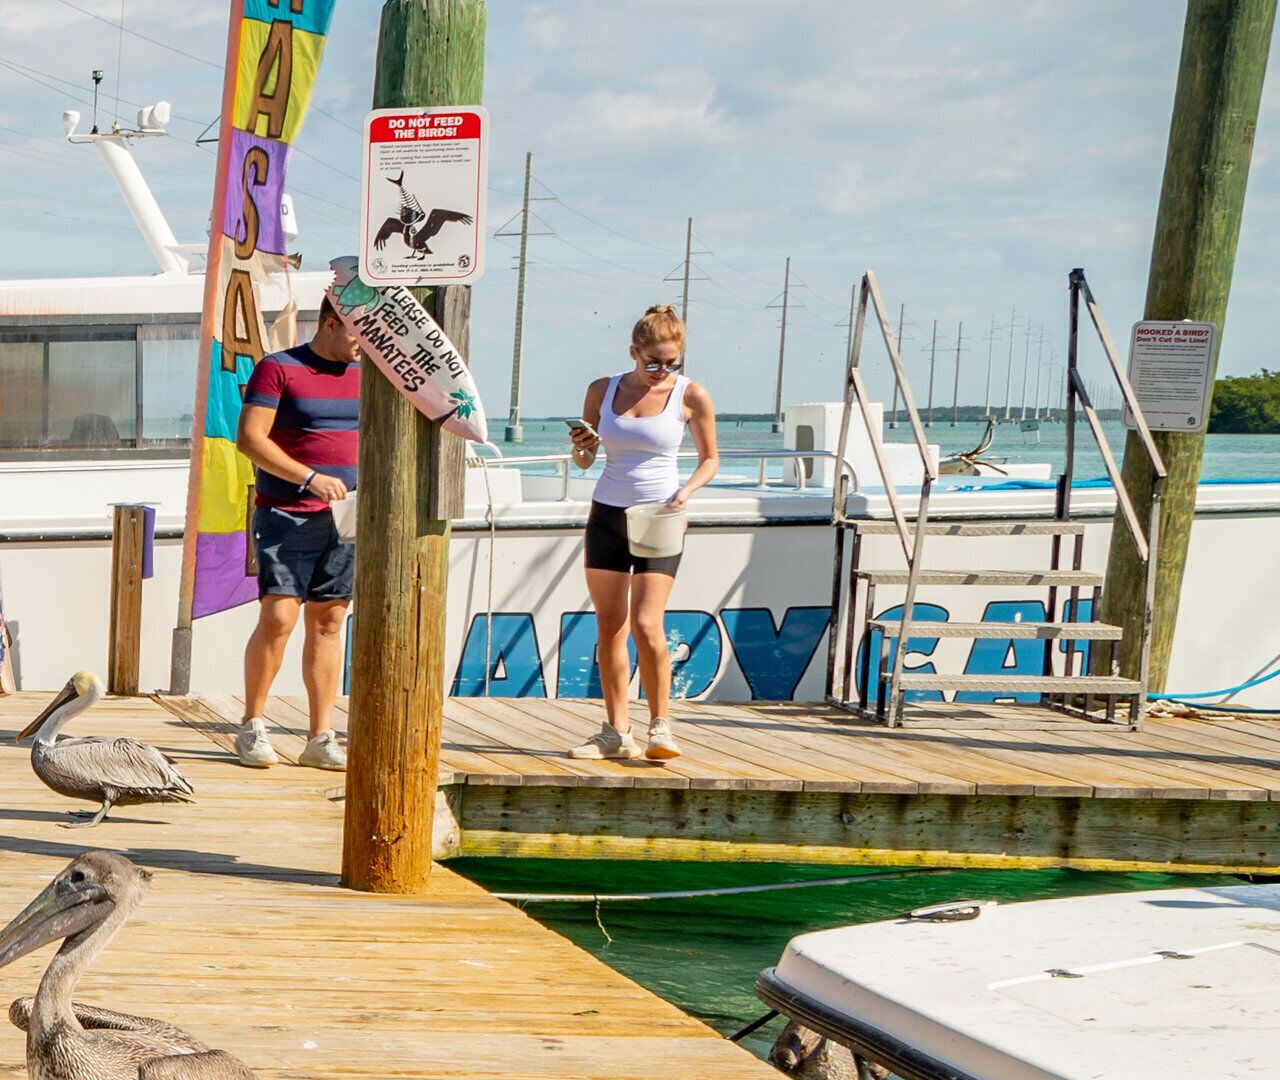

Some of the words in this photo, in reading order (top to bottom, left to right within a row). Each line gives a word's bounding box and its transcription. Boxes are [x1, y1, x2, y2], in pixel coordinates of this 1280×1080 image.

[388, 119, 406, 129] DO
[408, 118, 431, 128] NOT
[434, 116, 463, 126] FEED
[394, 129, 415, 139] THE
[418, 127, 457, 138] BIRDS!
[353, 314, 426, 392] MANATEES
[372, 303, 409, 337] FEED
[411, 344, 441, 376] THE
[380, 286, 429, 329] PLEASE
[425, 329, 444, 349] DO
[440, 351, 467, 379] NOT
[1137, 328, 1173, 336] HOOKED
[1182, 329, 1210, 337] BIRD?
[449, 606, 833, 700] APPY
